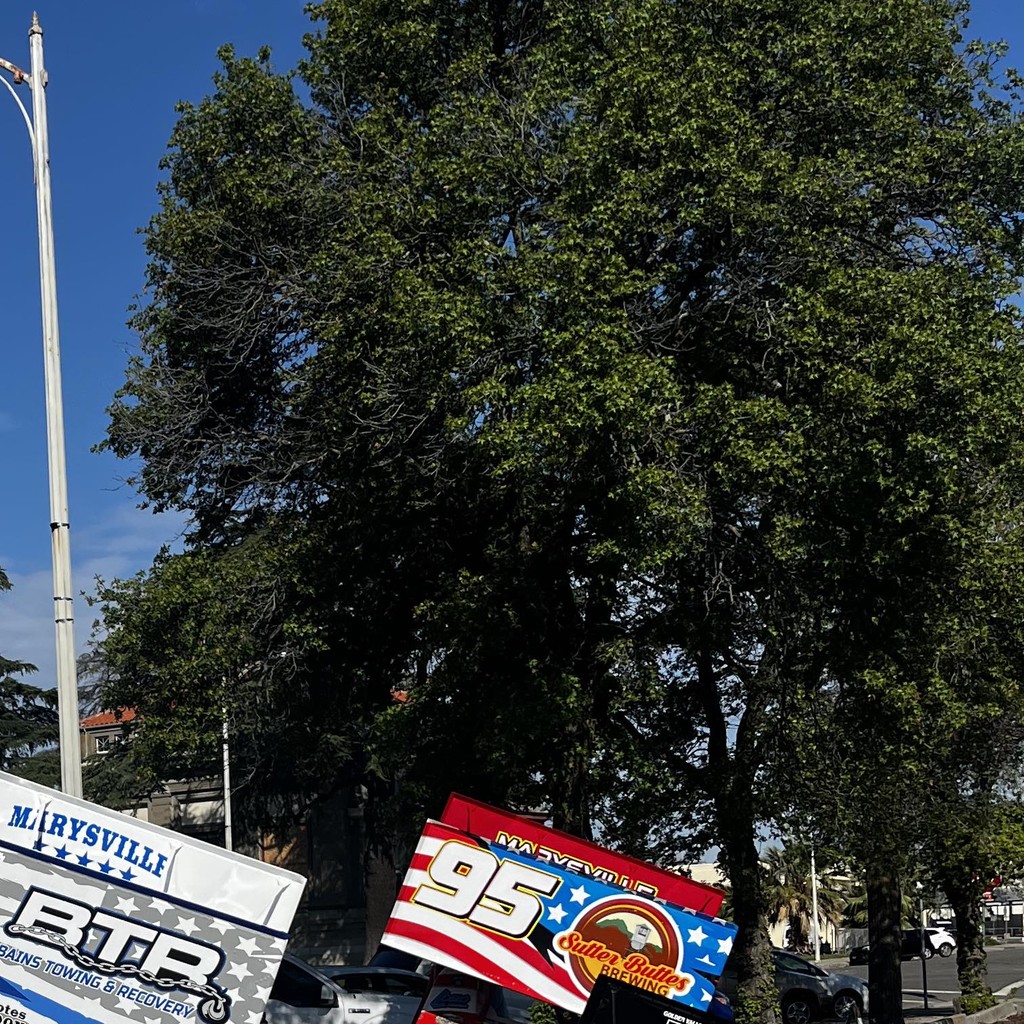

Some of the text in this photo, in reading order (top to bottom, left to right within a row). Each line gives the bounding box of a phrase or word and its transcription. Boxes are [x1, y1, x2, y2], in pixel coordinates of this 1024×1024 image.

[413, 840, 563, 938] 95
[12, 890, 222, 986] BTR
[559, 933, 688, 991] Sutter Buttes
[45, 960, 100, 989] TOWING
[100, 981, 115, 994] &
[116, 986, 195, 1019] RECOVERY
[600, 964, 669, 996] BREWING
